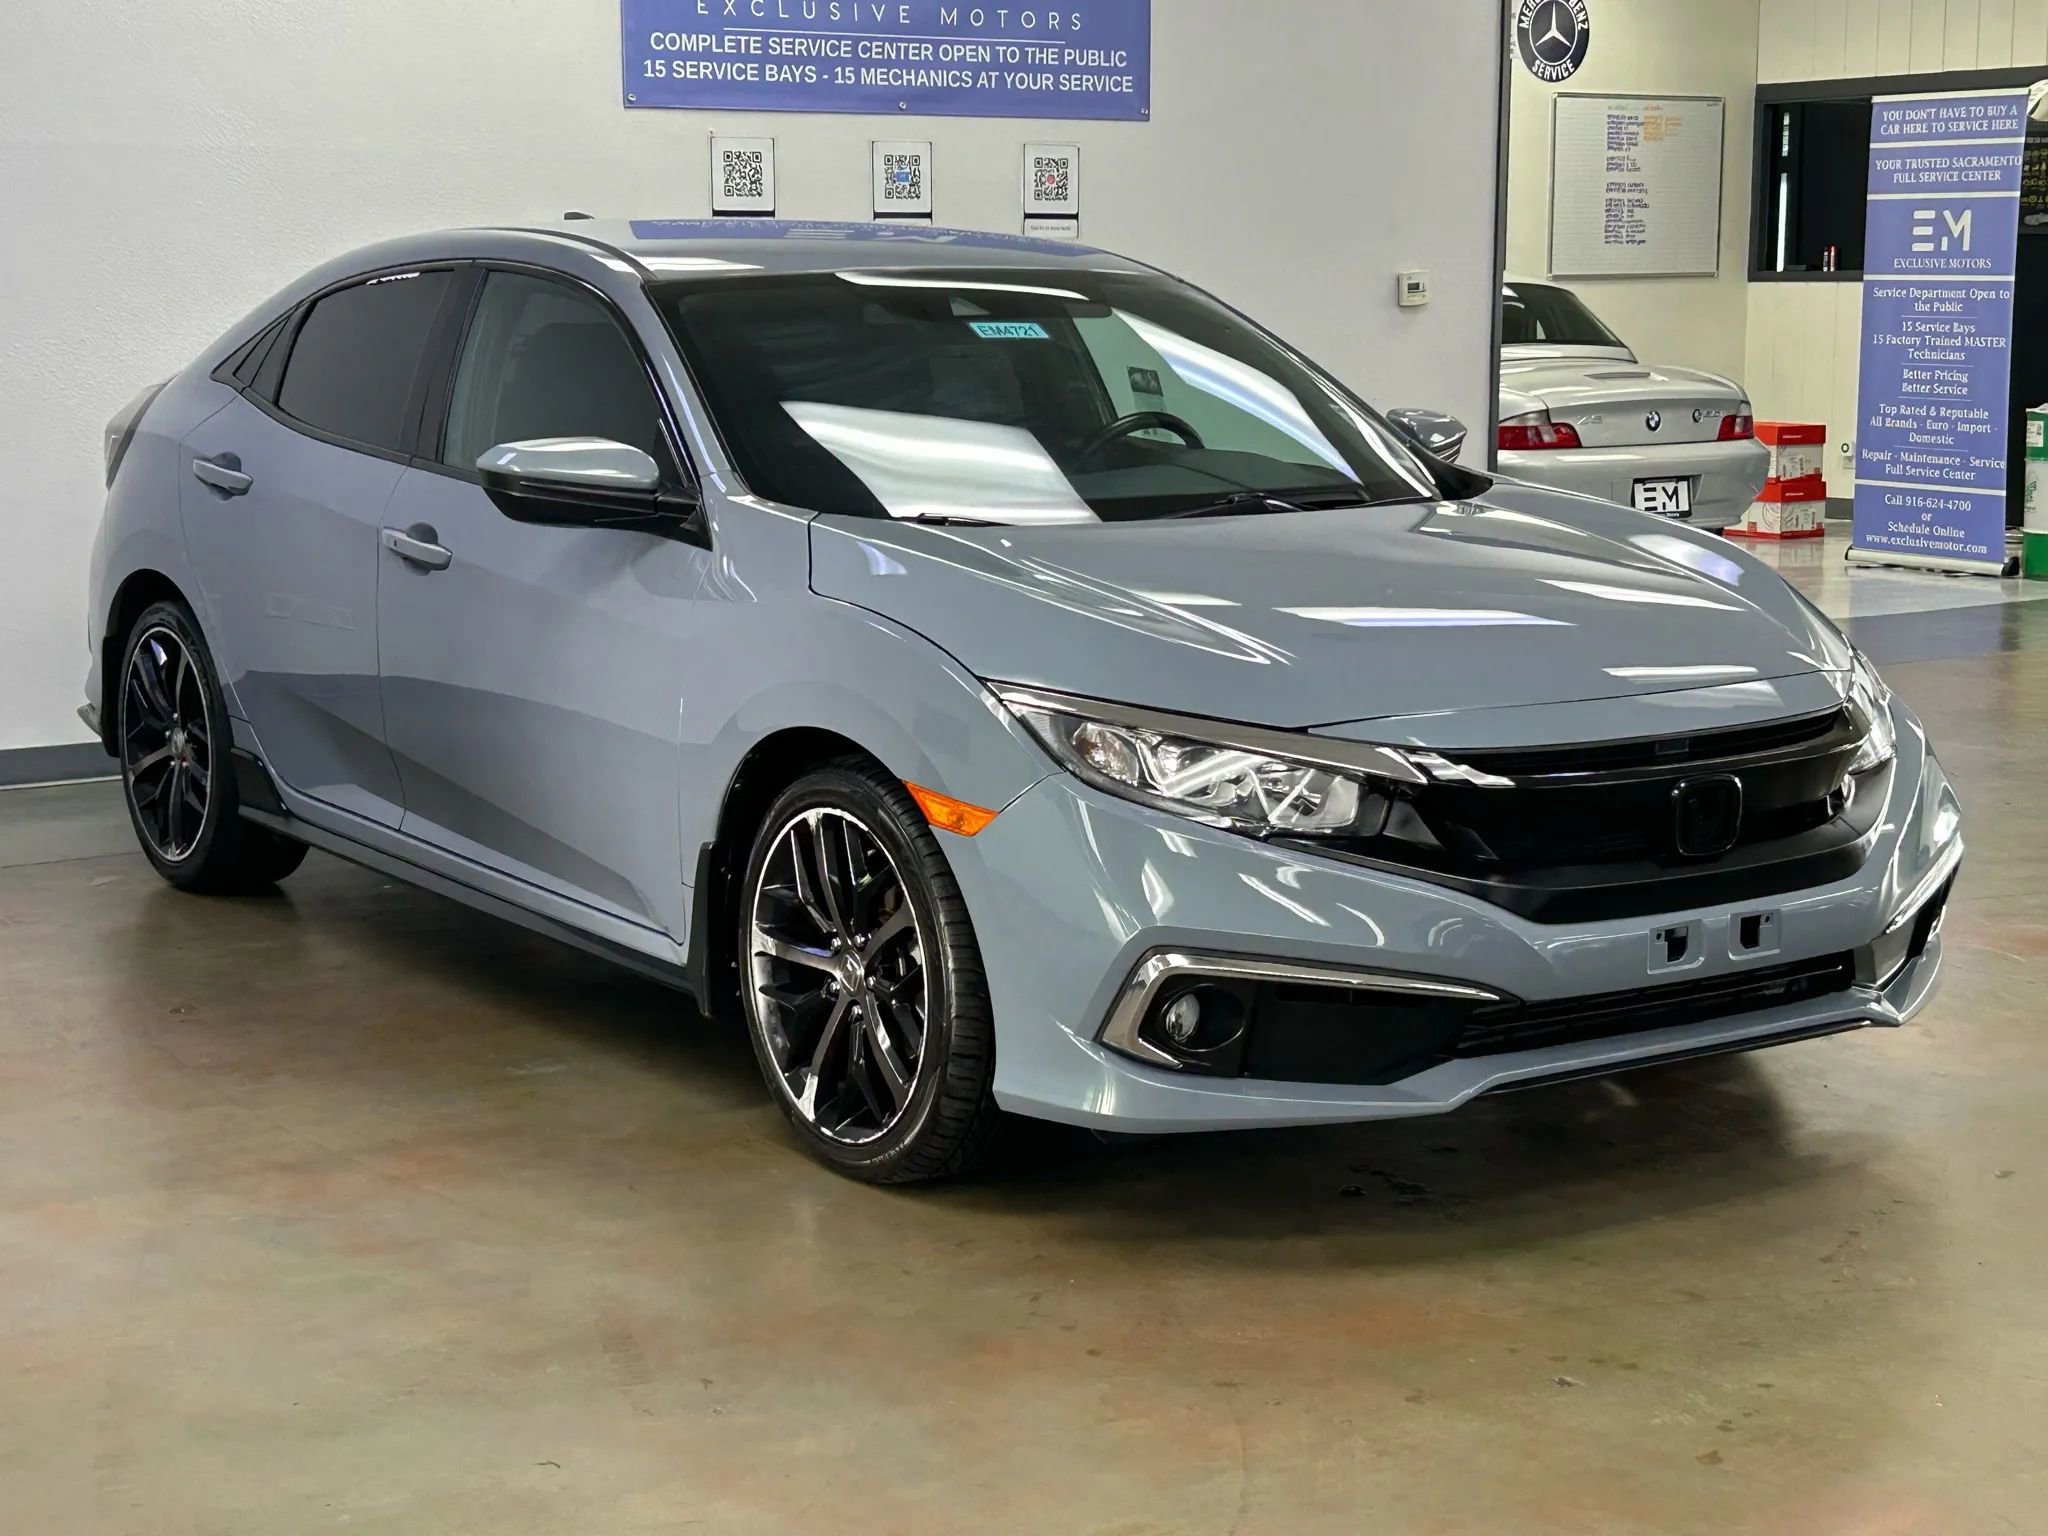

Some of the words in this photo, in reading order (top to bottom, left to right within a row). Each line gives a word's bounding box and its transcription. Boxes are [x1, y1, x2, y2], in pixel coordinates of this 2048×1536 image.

[697, 0, 910, 24] EXCLUSIVE
[940, 7, 1081, 31] MOTORS
[650, 32, 762, 55] COMPLETE
[768, 37, 853, 58] SERVICE
[858, 41, 934, 62] CENTER
[938, 44, 991, 63] OPEN
[995, 46, 1020, 64] TO
[1024, 47, 1059, 66] THE
[1064, 49, 1127, 68] PUBLIC
[643, 59, 667, 78] 15
[672, 60, 759, 81] SERVICE
[765, 63, 817, 83] BAYS
[834, 66, 856, 84] 15
[861, 67, 973, 88] MECHANICS
[976, 71, 999, 89] AT
[1003, 71, 1054, 91] YOUR
[1059, 73, 1134, 93] SERVICE
[1531, 59, 1575, 80] SERVICE
[1882, 109, 1903, 122] YOU
[1905, 108, 1937, 120] DON'T
[1939, 107, 1967, 119] HAVE
[1968, 106, 1984, 118] TO
[1987, 105, 2008, 117] BUY
[2009, 104, 2018, 116] A
[1880, 123, 1900, 135] CAR
[1903, 122, 1928, 134] HERE
[1931, 121, 1945, 133] TO
[1948, 120, 1989, 132] SERVICE
[1991, 118, 2019, 131] HERE
[1875, 159, 1902, 171] YOUR
[1905, 157, 1950, 169] TRUSTED
[1951, 155, 2022, 168] SACRAMENTO
[1893, 172, 1916, 184] FULL
[1919, 171, 1959, 183] SERVICE
[1961, 169, 2001, 182] CENTER
[1911, 209, 1972, 252] EM
[1893, 257, 1947, 269] EXCLUSIVE
[1949, 257, 1992, 269] MOTORS
[1873, 287, 1907, 299] Service
[1909, 287, 1966, 300] Department
[1969, 288, 1996, 301] Open
[1999, 289, 2010, 299] to
[1914, 301, 1930, 312] the
[1933, 301, 1963, 312] Public
[976, 325, 1040, 337] EM4721
[1902, 321, 1913, 332] 15
[1915, 321, 1950, 333] Service
[1953, 322, 1976, 335] Bays
[1872, 334, 1883, 345] 15
[1886, 334, 1921, 347] Factory
[1924, 335, 1961, 347] Trained
[1964, 336, 2007, 348] MASTER
[1907, 348, 1966, 360] Technicians
[1903, 369, 1932, 380] Better
[1934, 370, 1969, 383] Pricing
[1901, 383, 1931, 394] Better
[1933, 383, 1968, 395] Service
[1878, 404, 1897, 416] Top
[1900, 404, 1927, 416] Rated
[1929, 406, 1937, 416] &
[1939, 407, 1989, 420] Reputable
[1869, 416, 1882, 427] All
[1885, 417, 1917, 429] Brands
[1926, 420, 1949, 431] Euro
[1957, 421, 1992, 434] Import
[1908, 432, 1955, 445] Domestic
[1862, 449, 1893, 462] Repair
[1900, 452, 1961, 466] Maintenance
[1969, 456, 2006, 469] Service
[1885, 464, 1903, 475] Full
[1905, 465, 1940, 478] Service
[1942, 467, 1976, 481] Center
[1643, 485, 1679, 512] EM
[1884, 494, 1903, 506] Call
[1905, 496, 1972, 512] 916-624-4700
[1921, 512, 1933, 522] or
[1887, 521, 1930, 535] Schedule
[1933, 525, 1965, 539] Online
[1865, 533, 1988, 555] www.exclusivemotor.com
